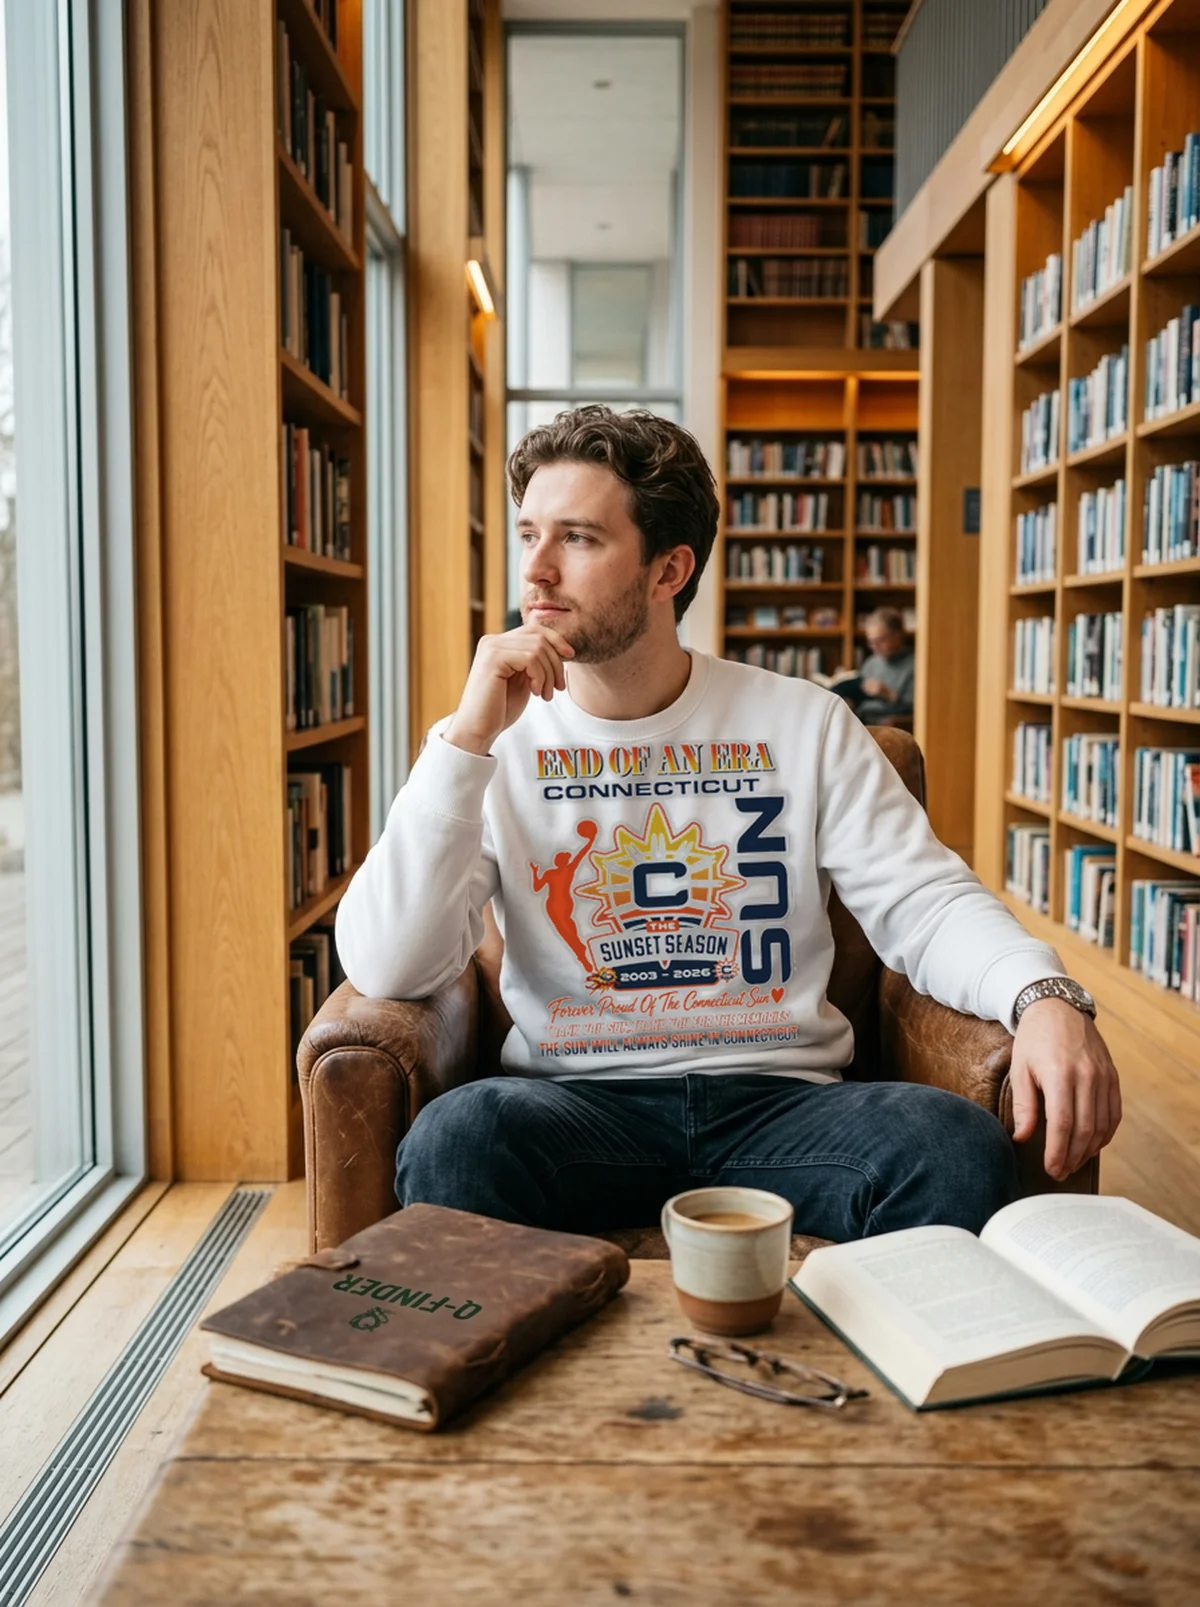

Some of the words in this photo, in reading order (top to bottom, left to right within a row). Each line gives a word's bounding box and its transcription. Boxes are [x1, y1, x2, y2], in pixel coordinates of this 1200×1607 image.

[537, 747, 604, 780] END
[609, 745, 651, 778] OF
[657, 743, 704, 775] AN
[710, 742, 776, 773] ERA
[543, 778, 760, 800] CONNECTICUT
[633, 861, 689, 908] C
[735, 796, 791, 985] SUN
[649, 922, 676, 931] THE
[600, 935, 661, 962] SUNSET
[665, 934, 728, 956] SEASON
[620, 971, 657, 982] 2003
[673, 968, 711, 979] 2026
[547, 996, 595, 1024] Forever
[596, 995, 638, 1017] Proud
[640, 993, 657, 1017] Of
[659, 989, 680, 1013] The
[683, 989, 746, 1011] Connecticut
[746, 986, 770, 1008] Sun
[539, 1041, 560, 1057] THE
[563, 1040, 588, 1056] SUN
[591, 1038, 619, 1054] WILL
[623, 1034, 668, 1051] ALWAYS
[671, 1031, 704, 1049] SHINE
[708, 1030, 719, 1046] IN
[723, 1026, 798, 1045] CONNECTICUT
[332, 1274, 482, 1320] Q-FINDER
